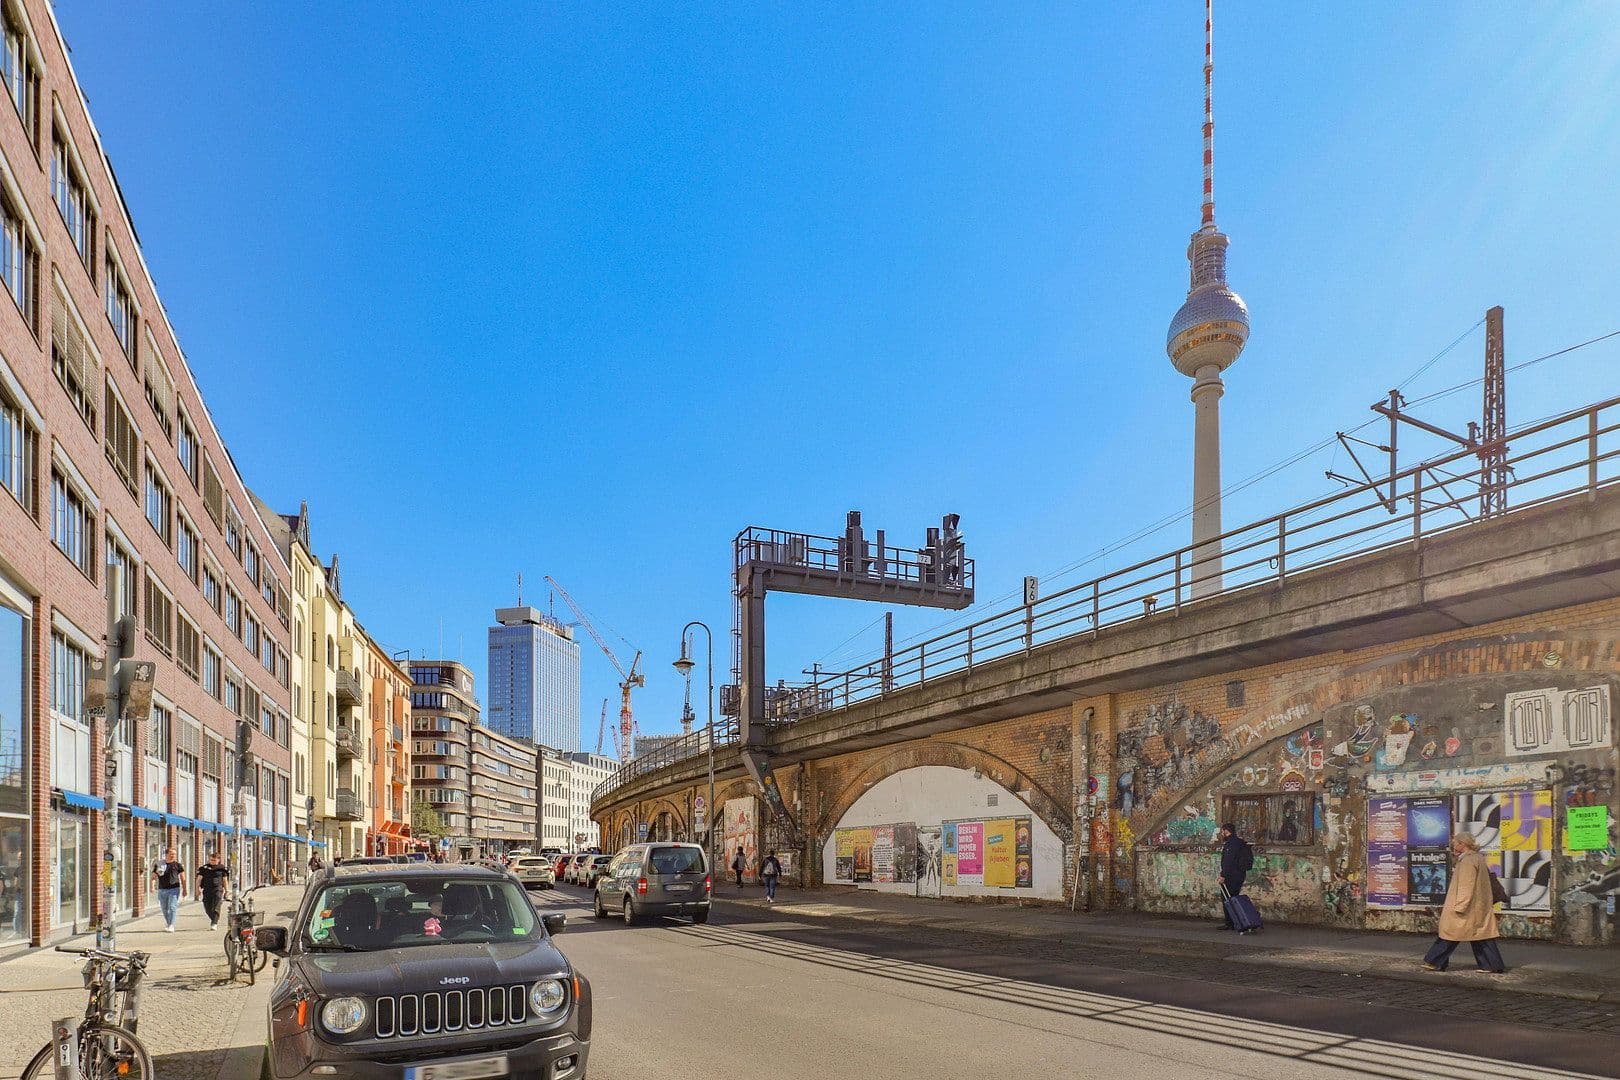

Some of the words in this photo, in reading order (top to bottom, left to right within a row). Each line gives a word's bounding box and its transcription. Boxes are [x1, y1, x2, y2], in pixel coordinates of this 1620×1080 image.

[959, 826, 977, 834] BERLIN
[959, 843, 977, 851] IMMER
[440, 976, 470, 985] Jeep
